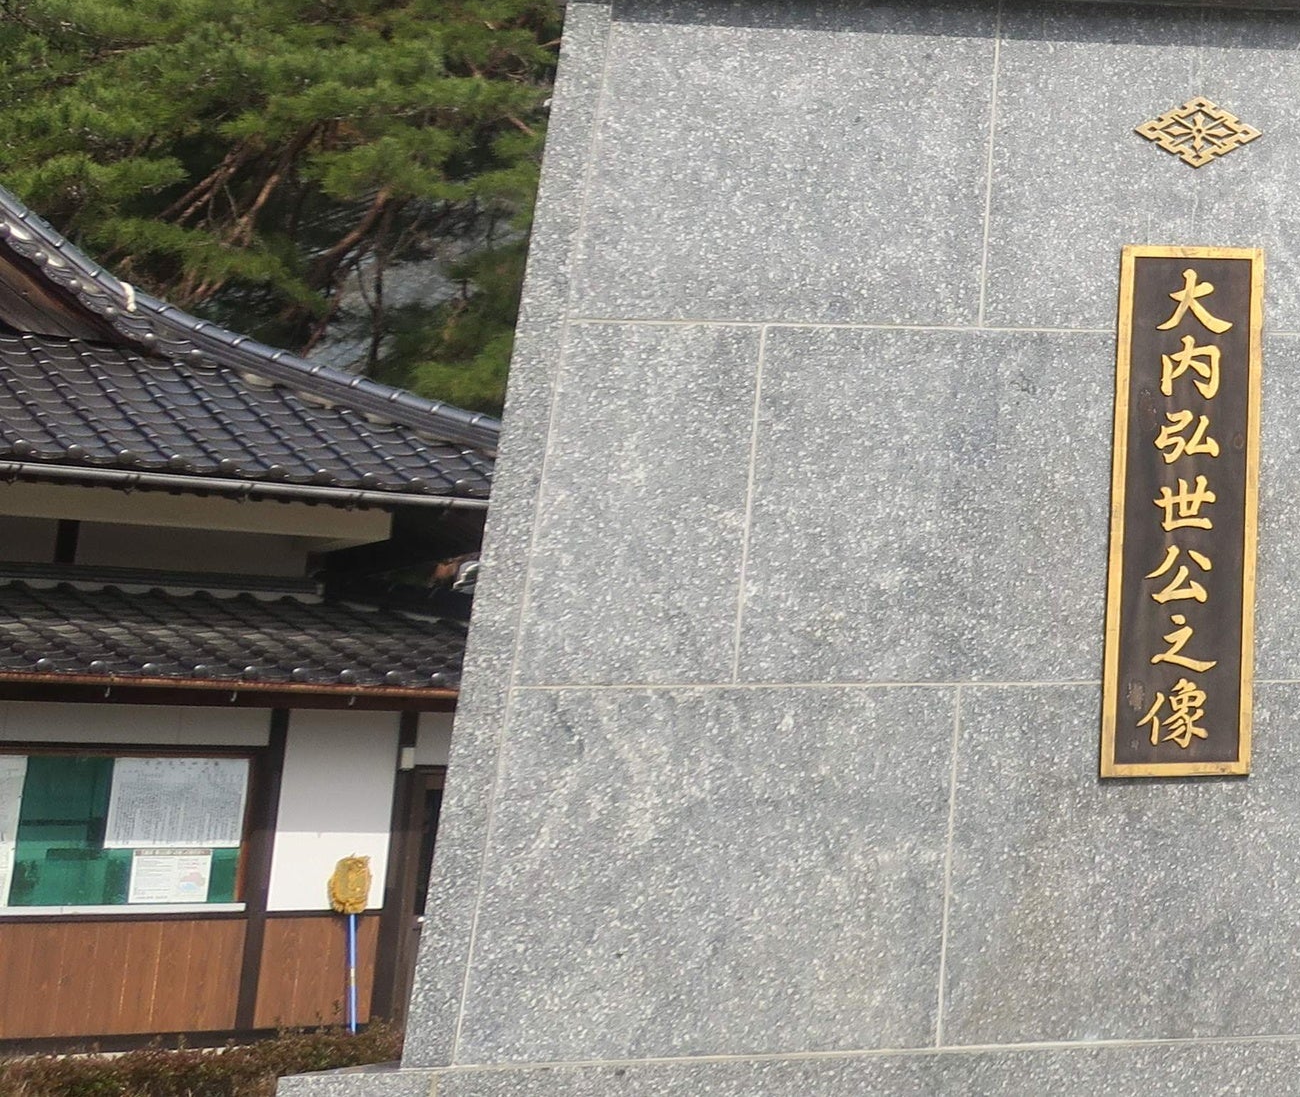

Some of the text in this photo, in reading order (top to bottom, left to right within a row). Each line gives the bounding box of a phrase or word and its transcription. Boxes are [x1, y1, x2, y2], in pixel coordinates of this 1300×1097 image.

[1136, 267, 1233, 749] 大内弘世公之像
